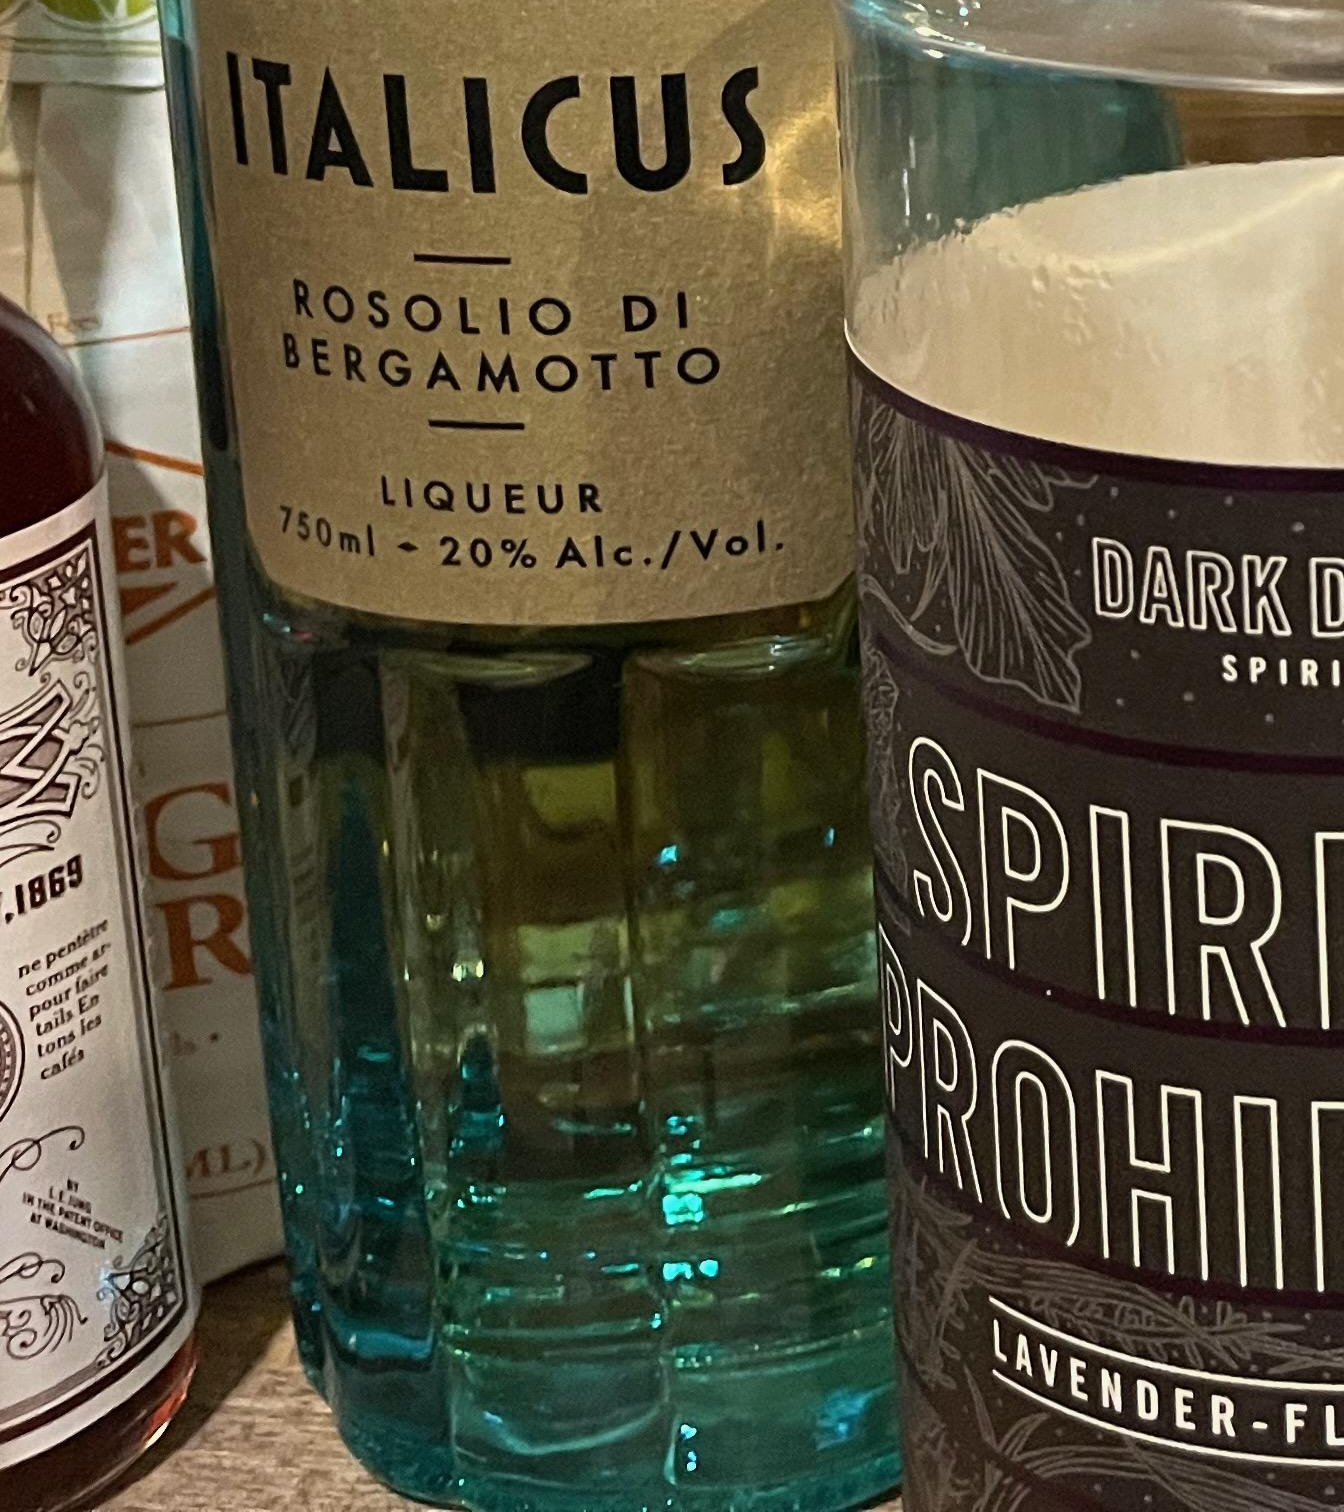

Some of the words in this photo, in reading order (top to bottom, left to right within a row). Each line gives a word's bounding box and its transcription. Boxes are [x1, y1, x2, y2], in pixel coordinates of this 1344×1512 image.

[226, 50, 766, 195] ITALICUS
[293, 277, 573, 337] ROSOLIO
[623, 291, 689, 334] DI
[282, 332, 722, 394] BERGAMOTTO
[380, 474, 604, 515] LIQUEUR
[278, 504, 375, 557] 750ml
[439, 536, 538, 570] 20%
[556, 519, 785, 570] Alc./Vol.
[1092, 536, 1293, 638] DARK
[1, 853, 83, 925] .1869
[18, 958, 42, 979] ne
[25, 955, 89, 996] comme
[29, 986, 74, 1023] pour
